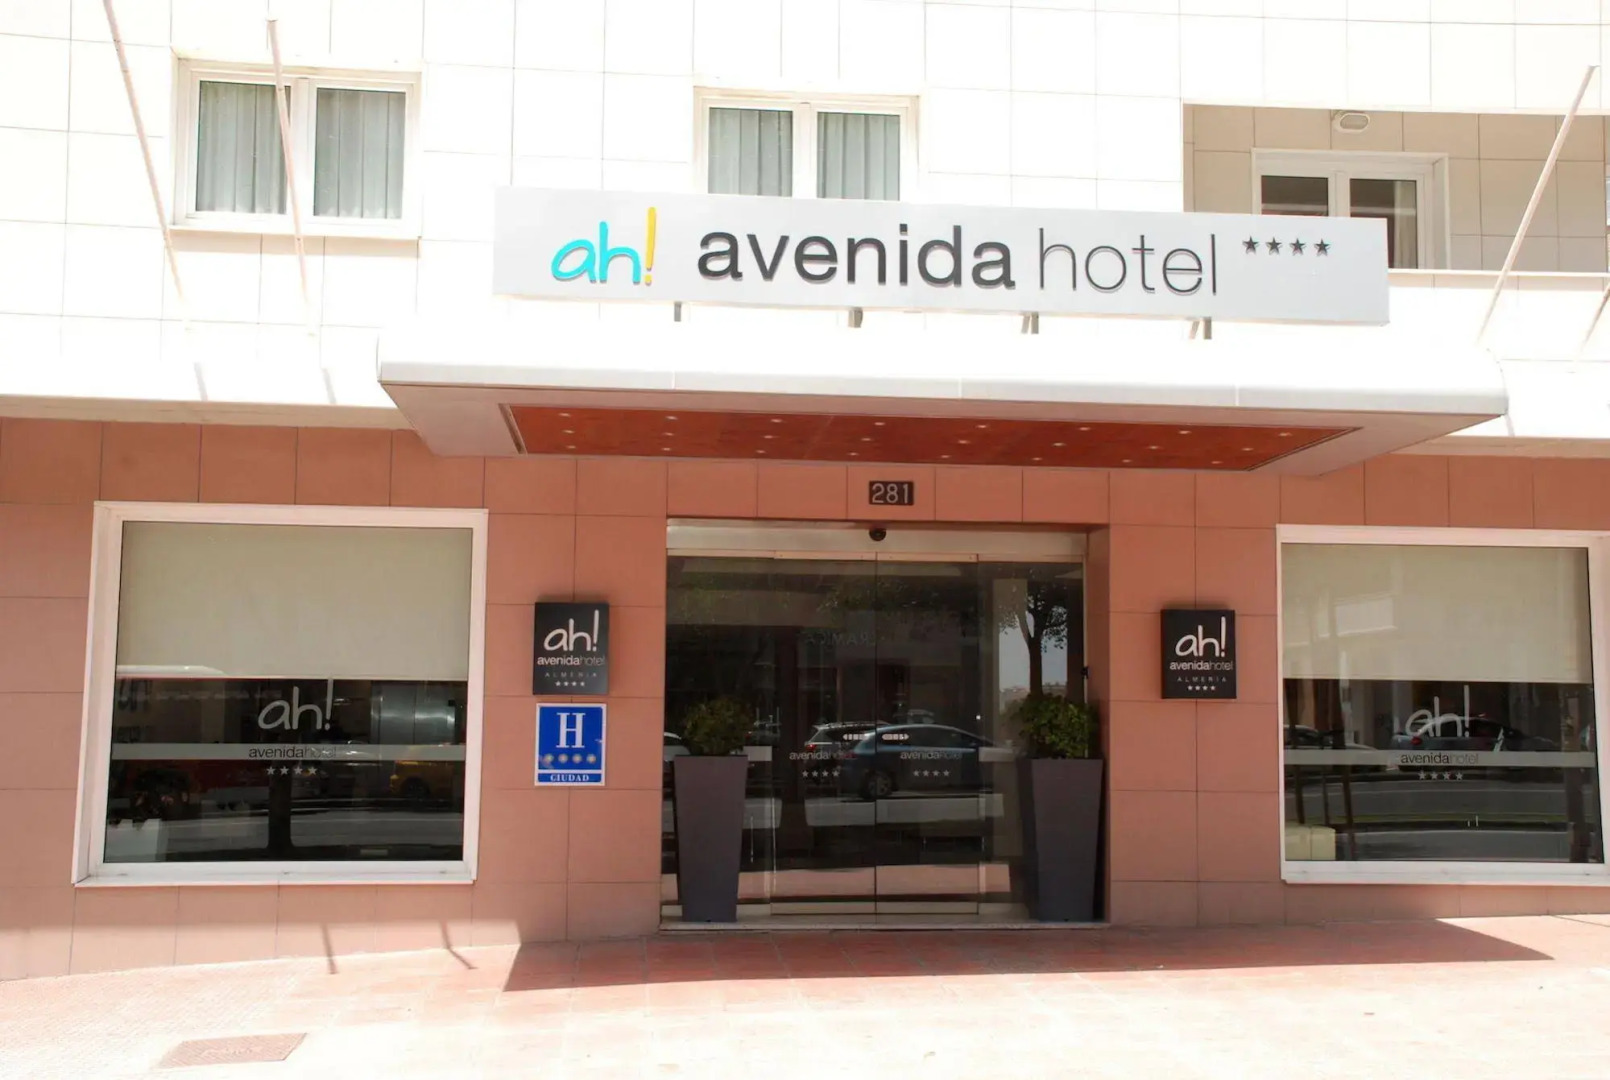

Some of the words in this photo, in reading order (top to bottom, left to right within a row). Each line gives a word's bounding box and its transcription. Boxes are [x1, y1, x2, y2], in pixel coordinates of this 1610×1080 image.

[551, 206, 657, 285] ah!
[698, 223, 1016, 290] avenida
[1038, 227, 1217, 296] hotel
[872, 482, 909, 504] 281
[543, 609, 600, 652] ah!
[1175, 616, 1227, 658] ah!
[257, 677, 334, 731] ah!
[1405, 684, 1470, 738] ah!
[550, 774, 590, 782] CIUDAD
